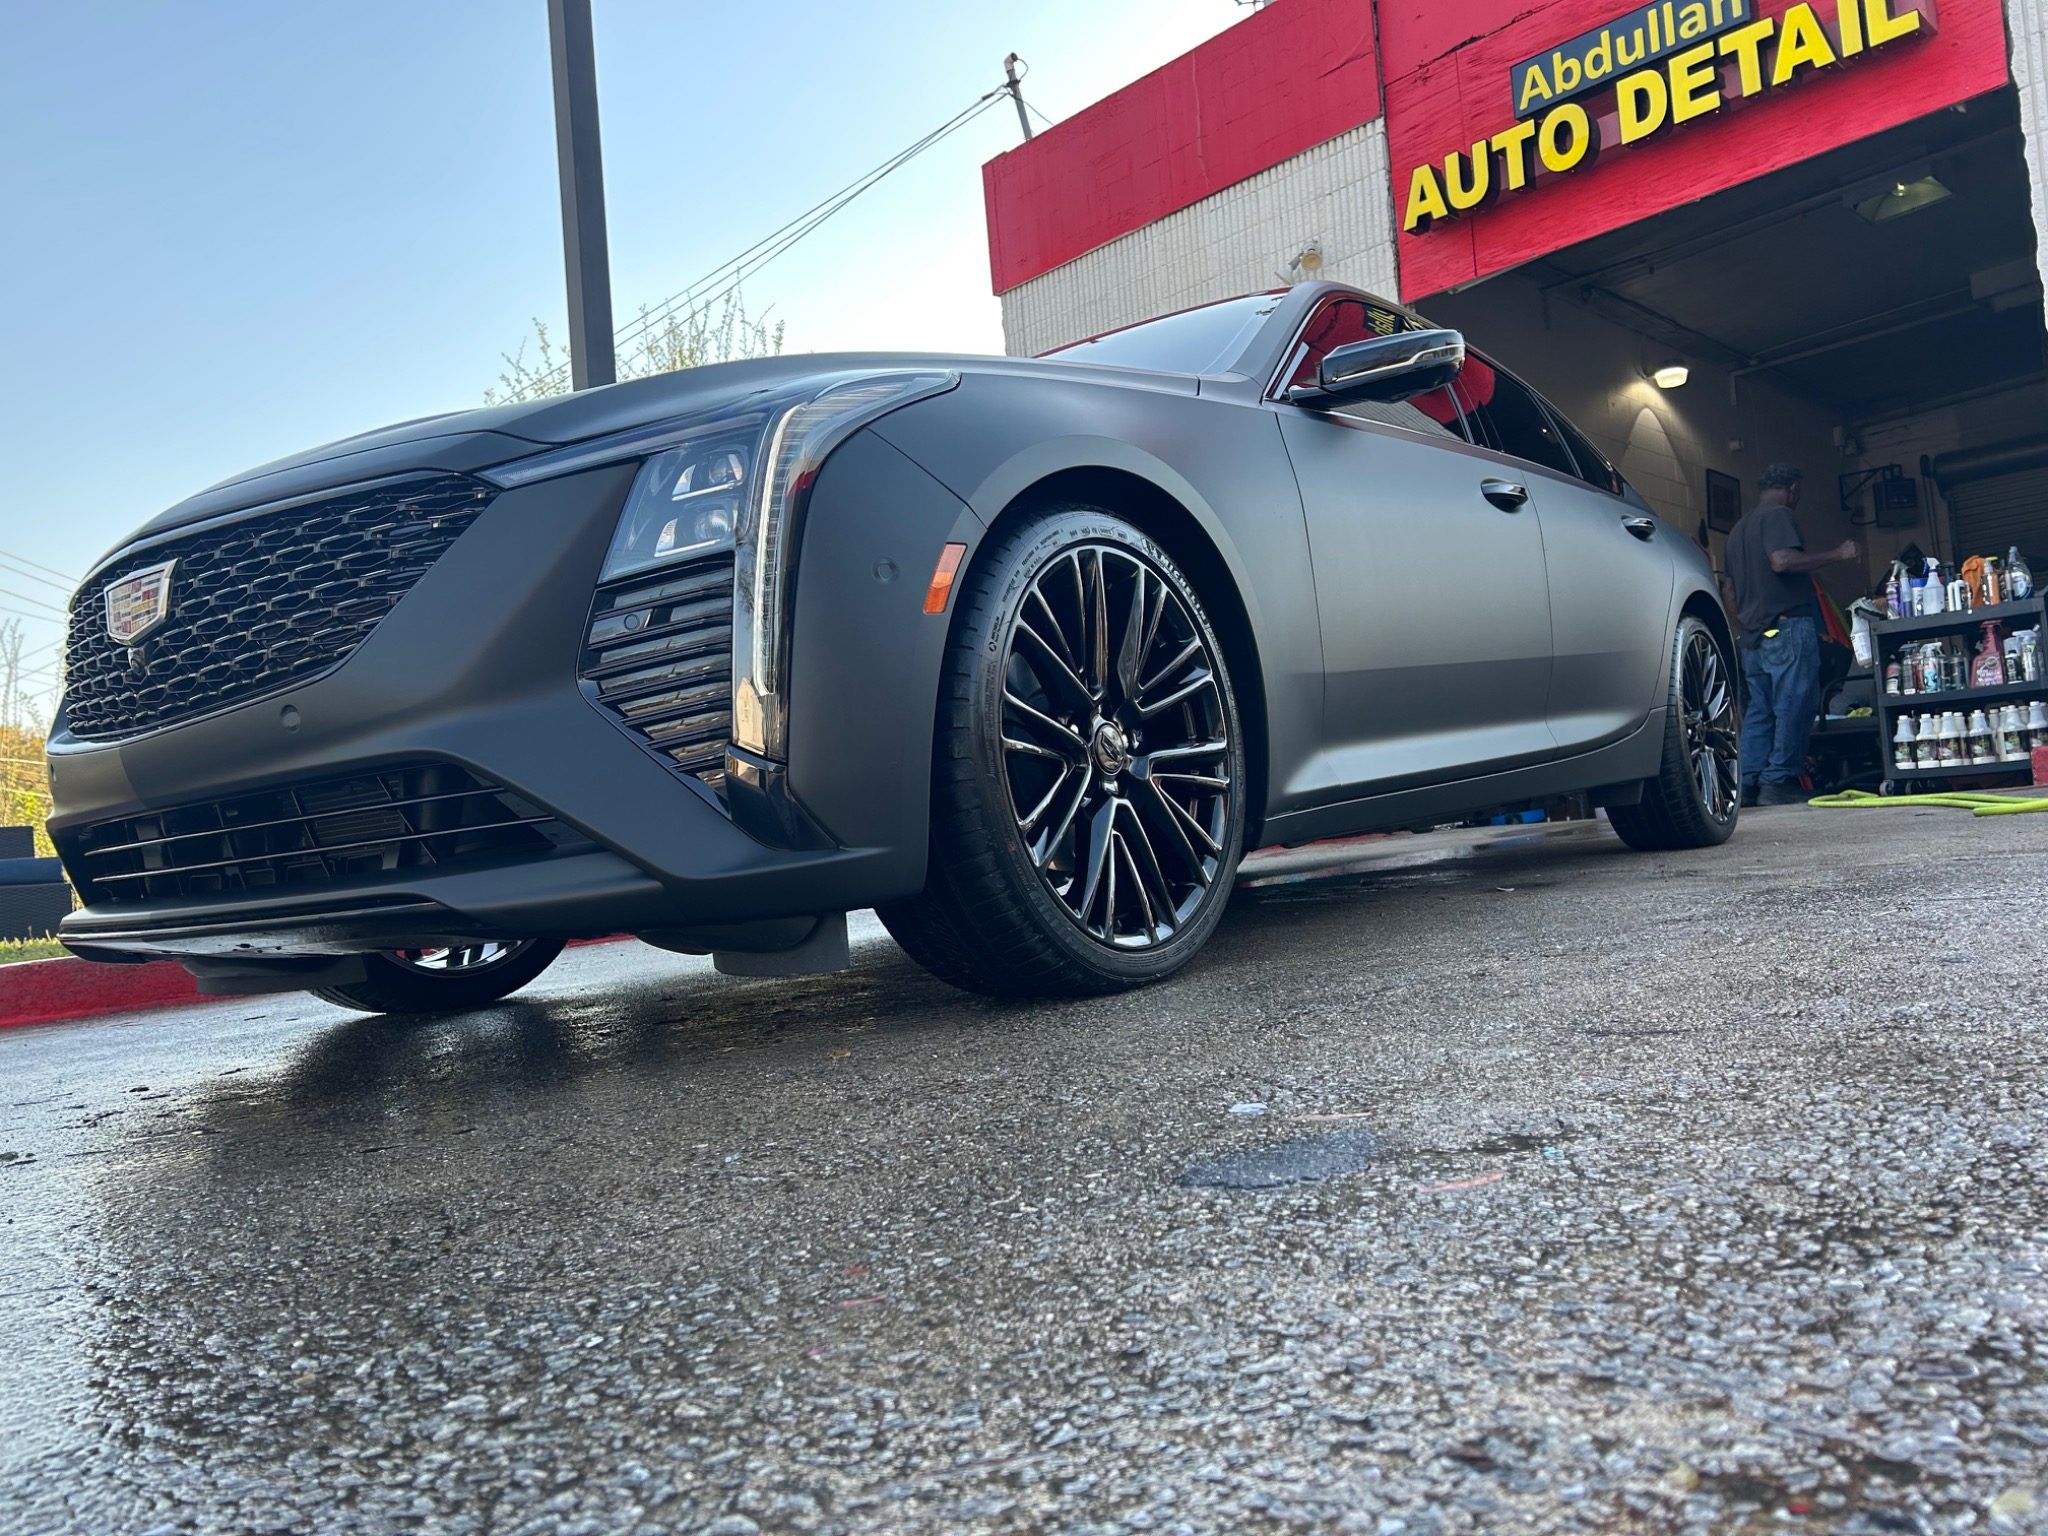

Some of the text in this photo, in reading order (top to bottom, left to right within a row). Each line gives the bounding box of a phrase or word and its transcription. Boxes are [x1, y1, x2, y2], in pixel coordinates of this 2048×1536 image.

[1403, 0, 1920, 232] AUTO DETAIL
[1160, 554, 1207, 621] MICHELIN
